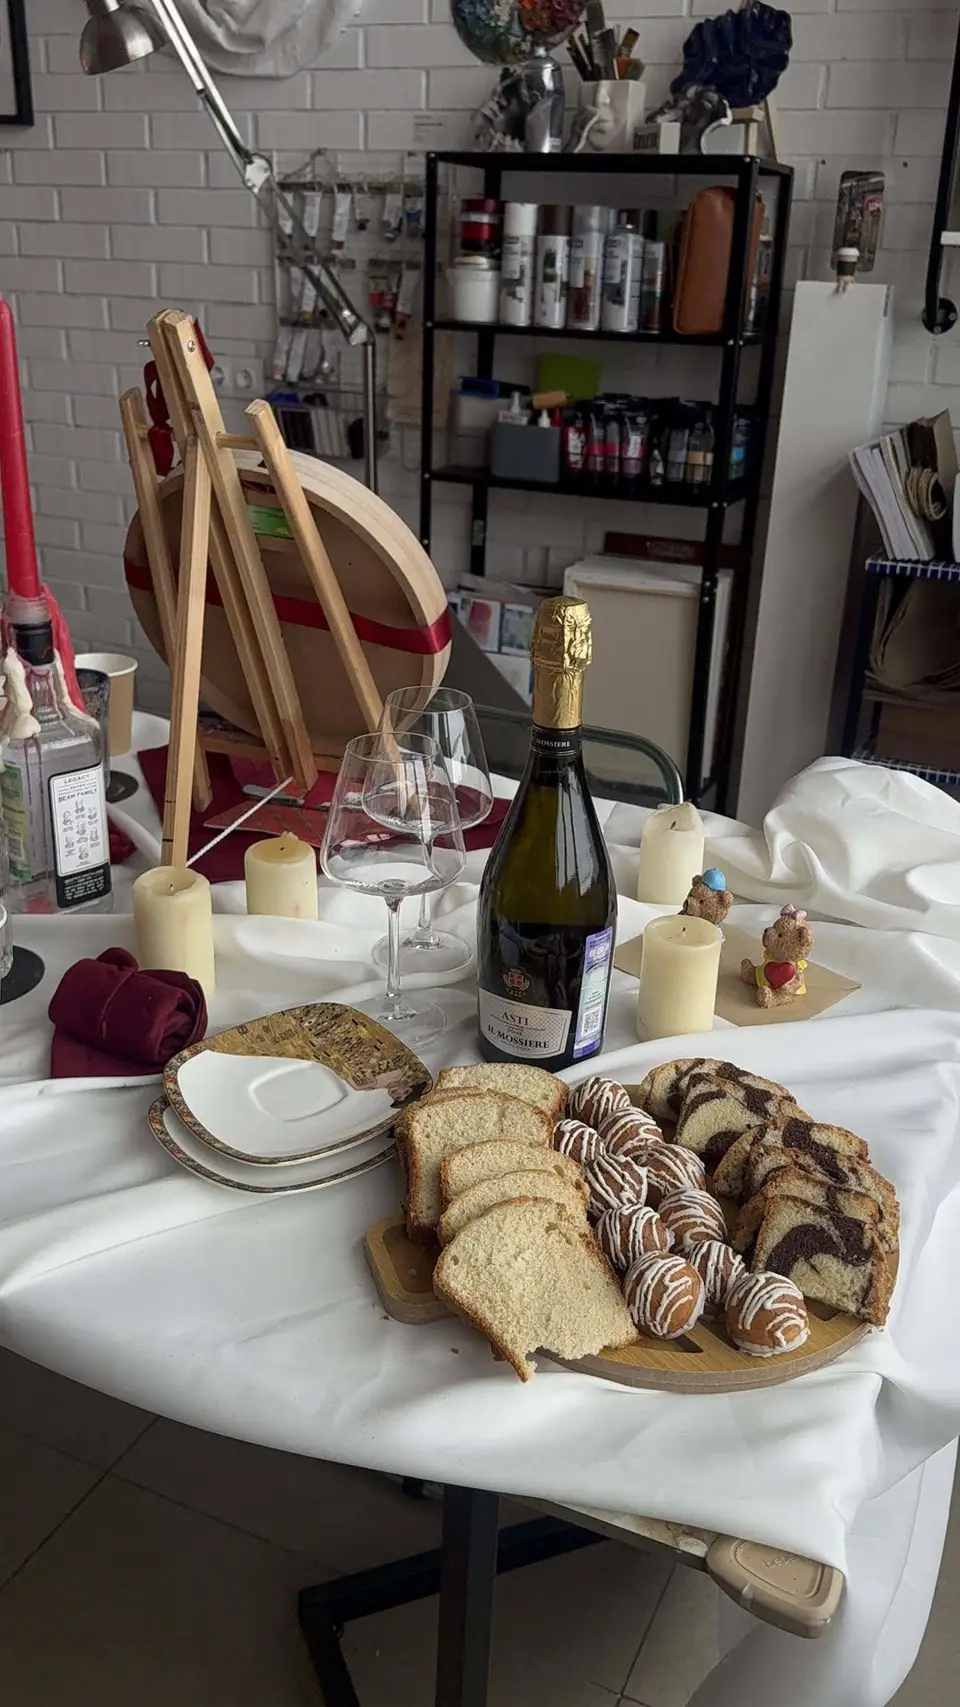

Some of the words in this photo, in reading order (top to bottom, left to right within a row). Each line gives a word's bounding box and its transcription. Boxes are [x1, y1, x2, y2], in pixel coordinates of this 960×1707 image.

[536, 738, 571, 748] MOSSIERE
[64, 774, 90, 784] LEGACY
[58, 794, 76, 803] BEAM
[77, 788, 97, 797] FAMILY
[502, 1011, 529, 1026] ASTI
[488, 1024, 496, 1035] IL
[497, 1030, 550, 1048] MOSSIERE
